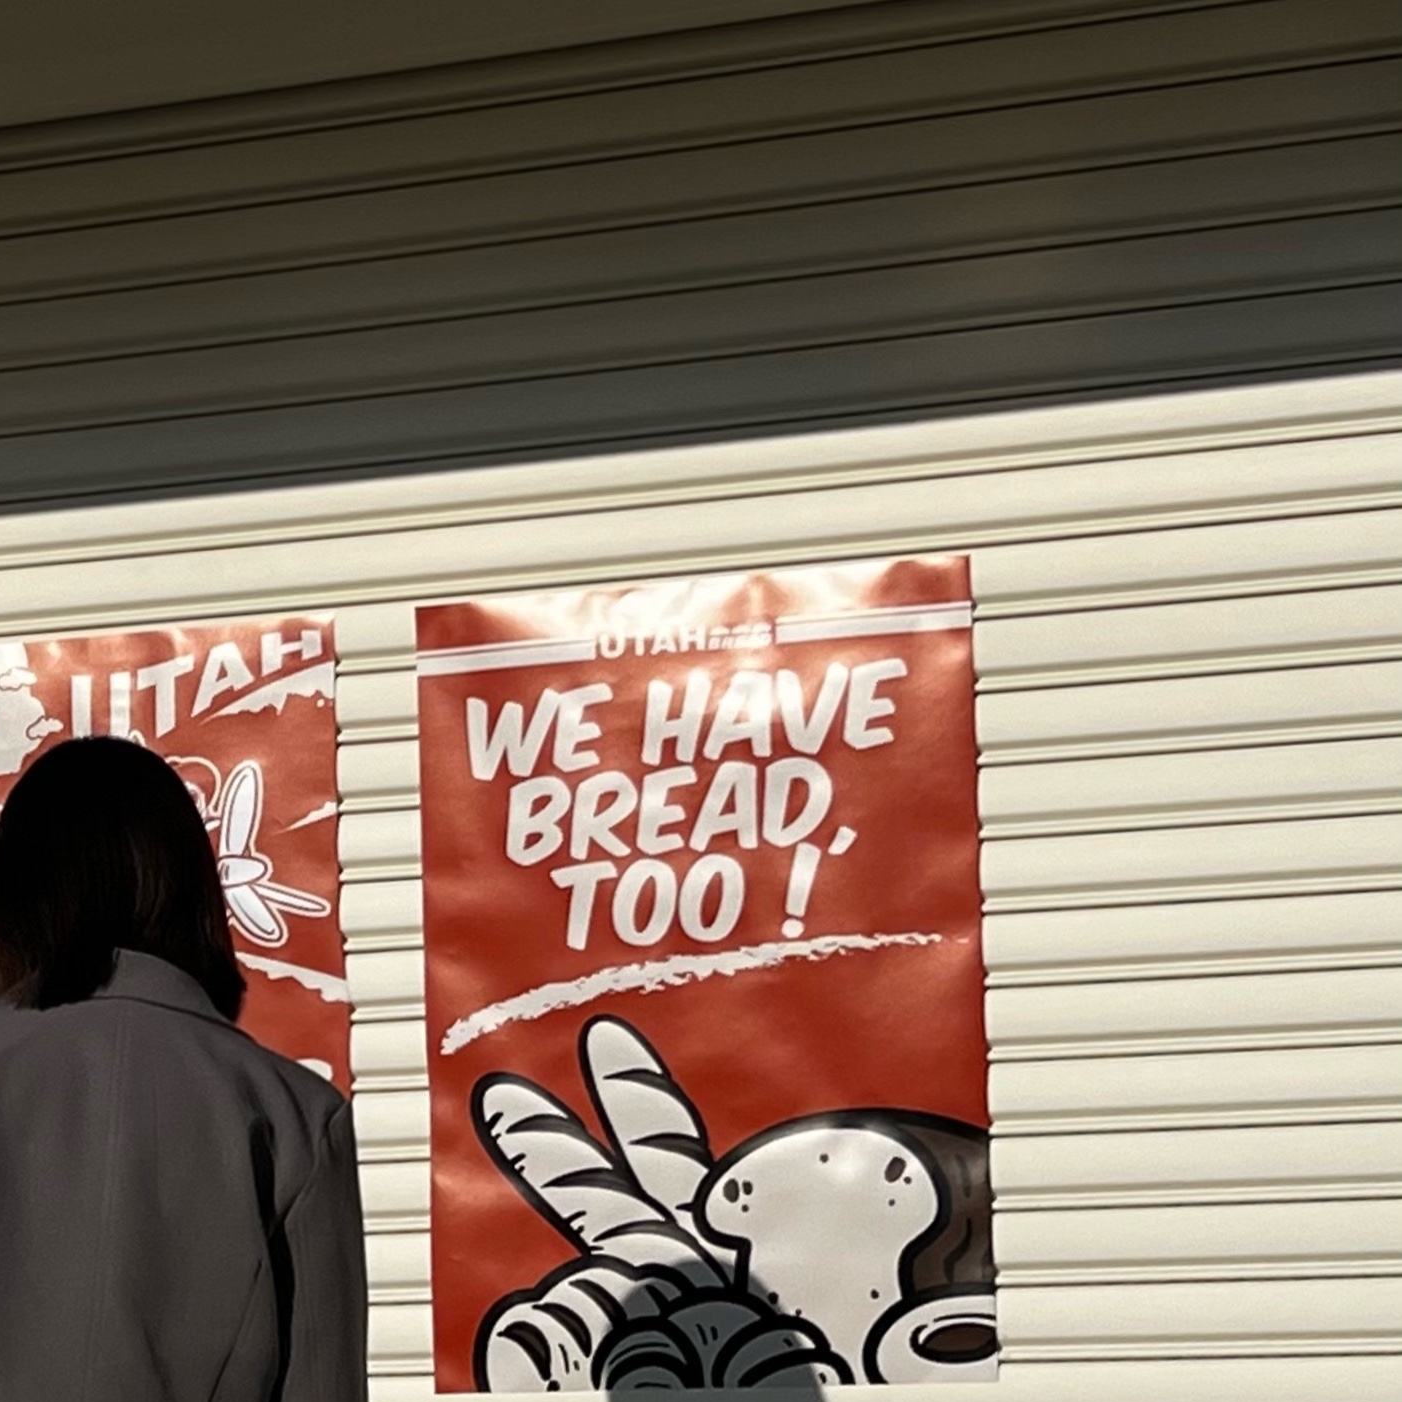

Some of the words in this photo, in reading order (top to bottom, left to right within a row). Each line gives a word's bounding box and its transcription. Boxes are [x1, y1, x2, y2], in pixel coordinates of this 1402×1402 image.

[69, 630, 322, 739] UTAH
[598, 625, 707, 660] UTAH
[466, 682, 614, 781] WE
[641, 657, 908, 766] HAVE
[506, 757, 857, 866] BREAD,
